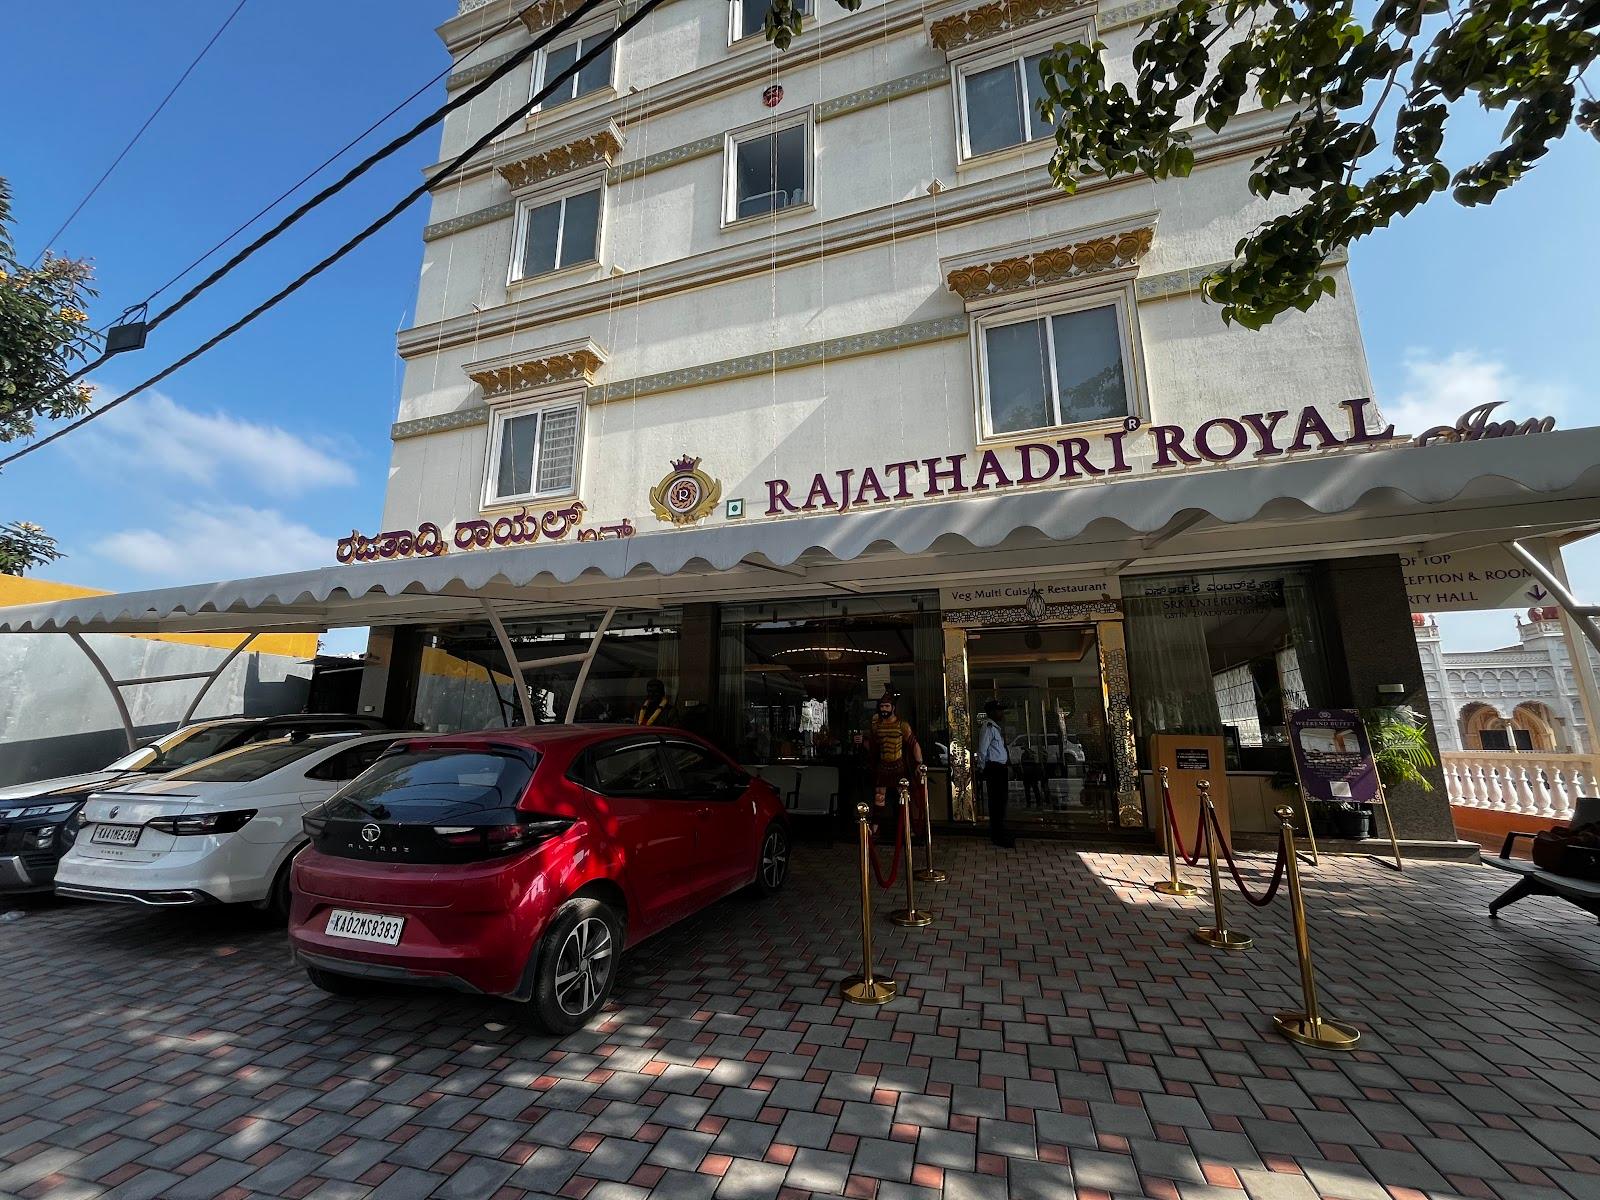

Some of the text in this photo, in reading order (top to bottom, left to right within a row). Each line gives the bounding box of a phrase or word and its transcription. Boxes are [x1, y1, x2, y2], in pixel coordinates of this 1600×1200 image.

[764, 430, 1132, 516] RAJATHADRI
[1149, 397, 1395, 469] ROYAL
[454, 501, 587, 551] ರಾಯಲ್
[1402, 572, 1464, 586] CEPTION
[951, 590, 972, 602] Veg
[975, 588, 1001, 599] Multi
[1047, 583, 1107, 595] Restaurant
[1408, 591, 1479, 605] RTY HALL
[333, 914, 399, 940] KA02MS8383
